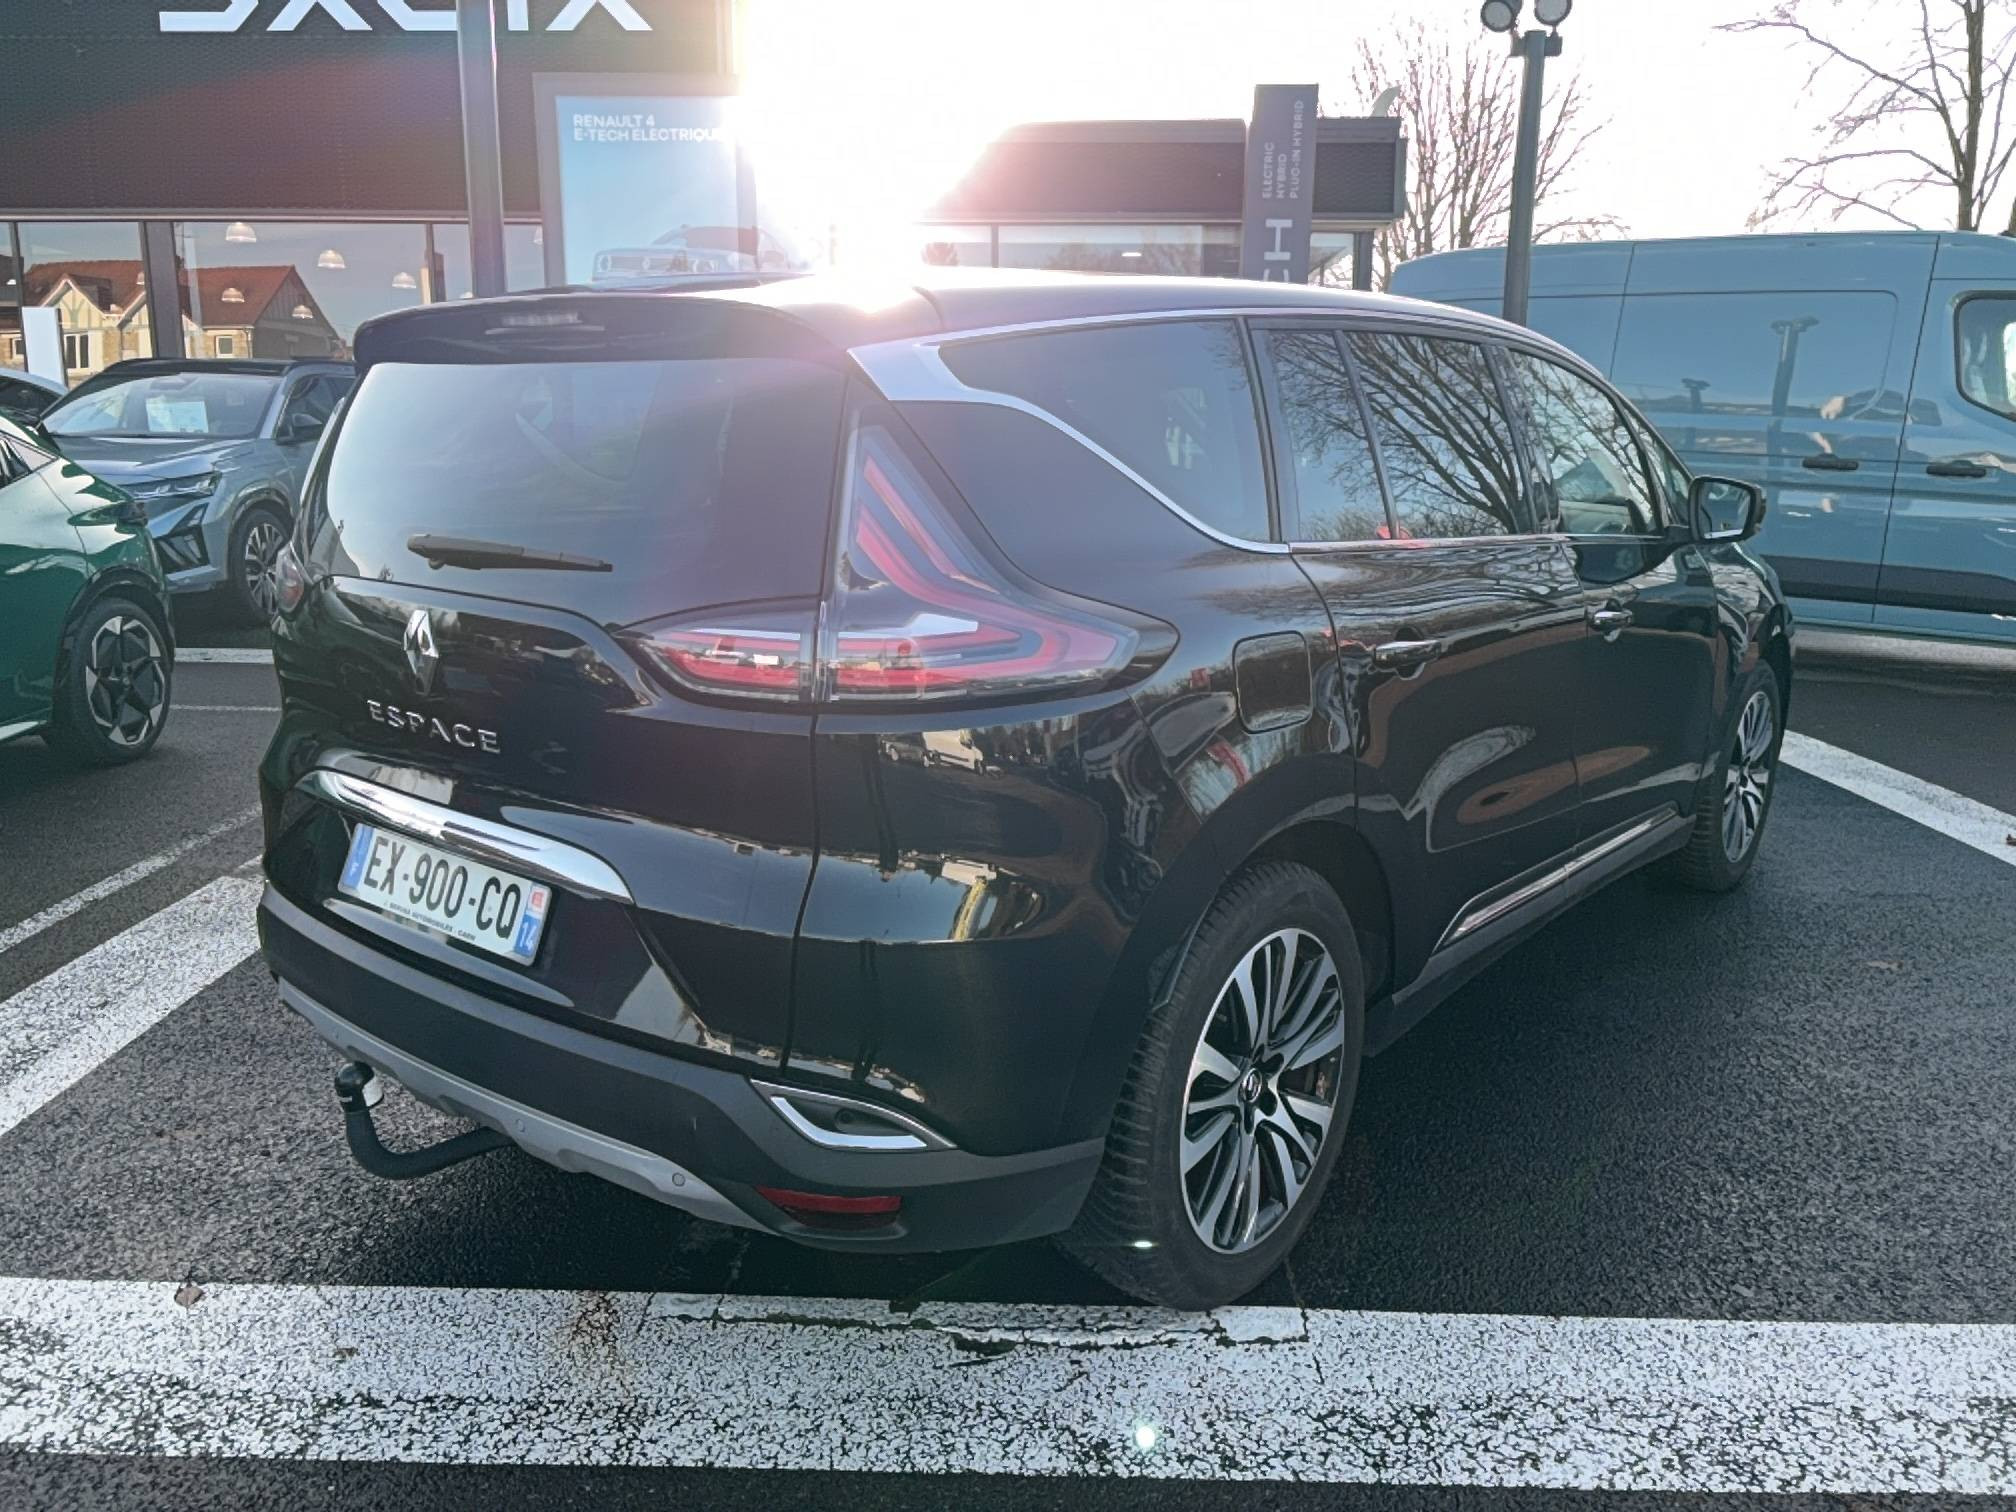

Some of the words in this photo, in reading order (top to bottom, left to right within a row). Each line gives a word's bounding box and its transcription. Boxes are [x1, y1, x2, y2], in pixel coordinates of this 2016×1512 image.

[573, 114, 643, 127] RENAULT
[645, 114, 656, 127] 4
[573, 127, 630, 142] E-TECH
[1293, 100, 1305, 146] HYBRID
[1262, 141, 1275, 199] ELECTRIC
[1276, 153, 1287, 199] HYBRID
[1289, 149, 1302, 199] PLUG-IN
[367, 699, 501, 754] ESPACE
[518, 921, 538, 951] 14
